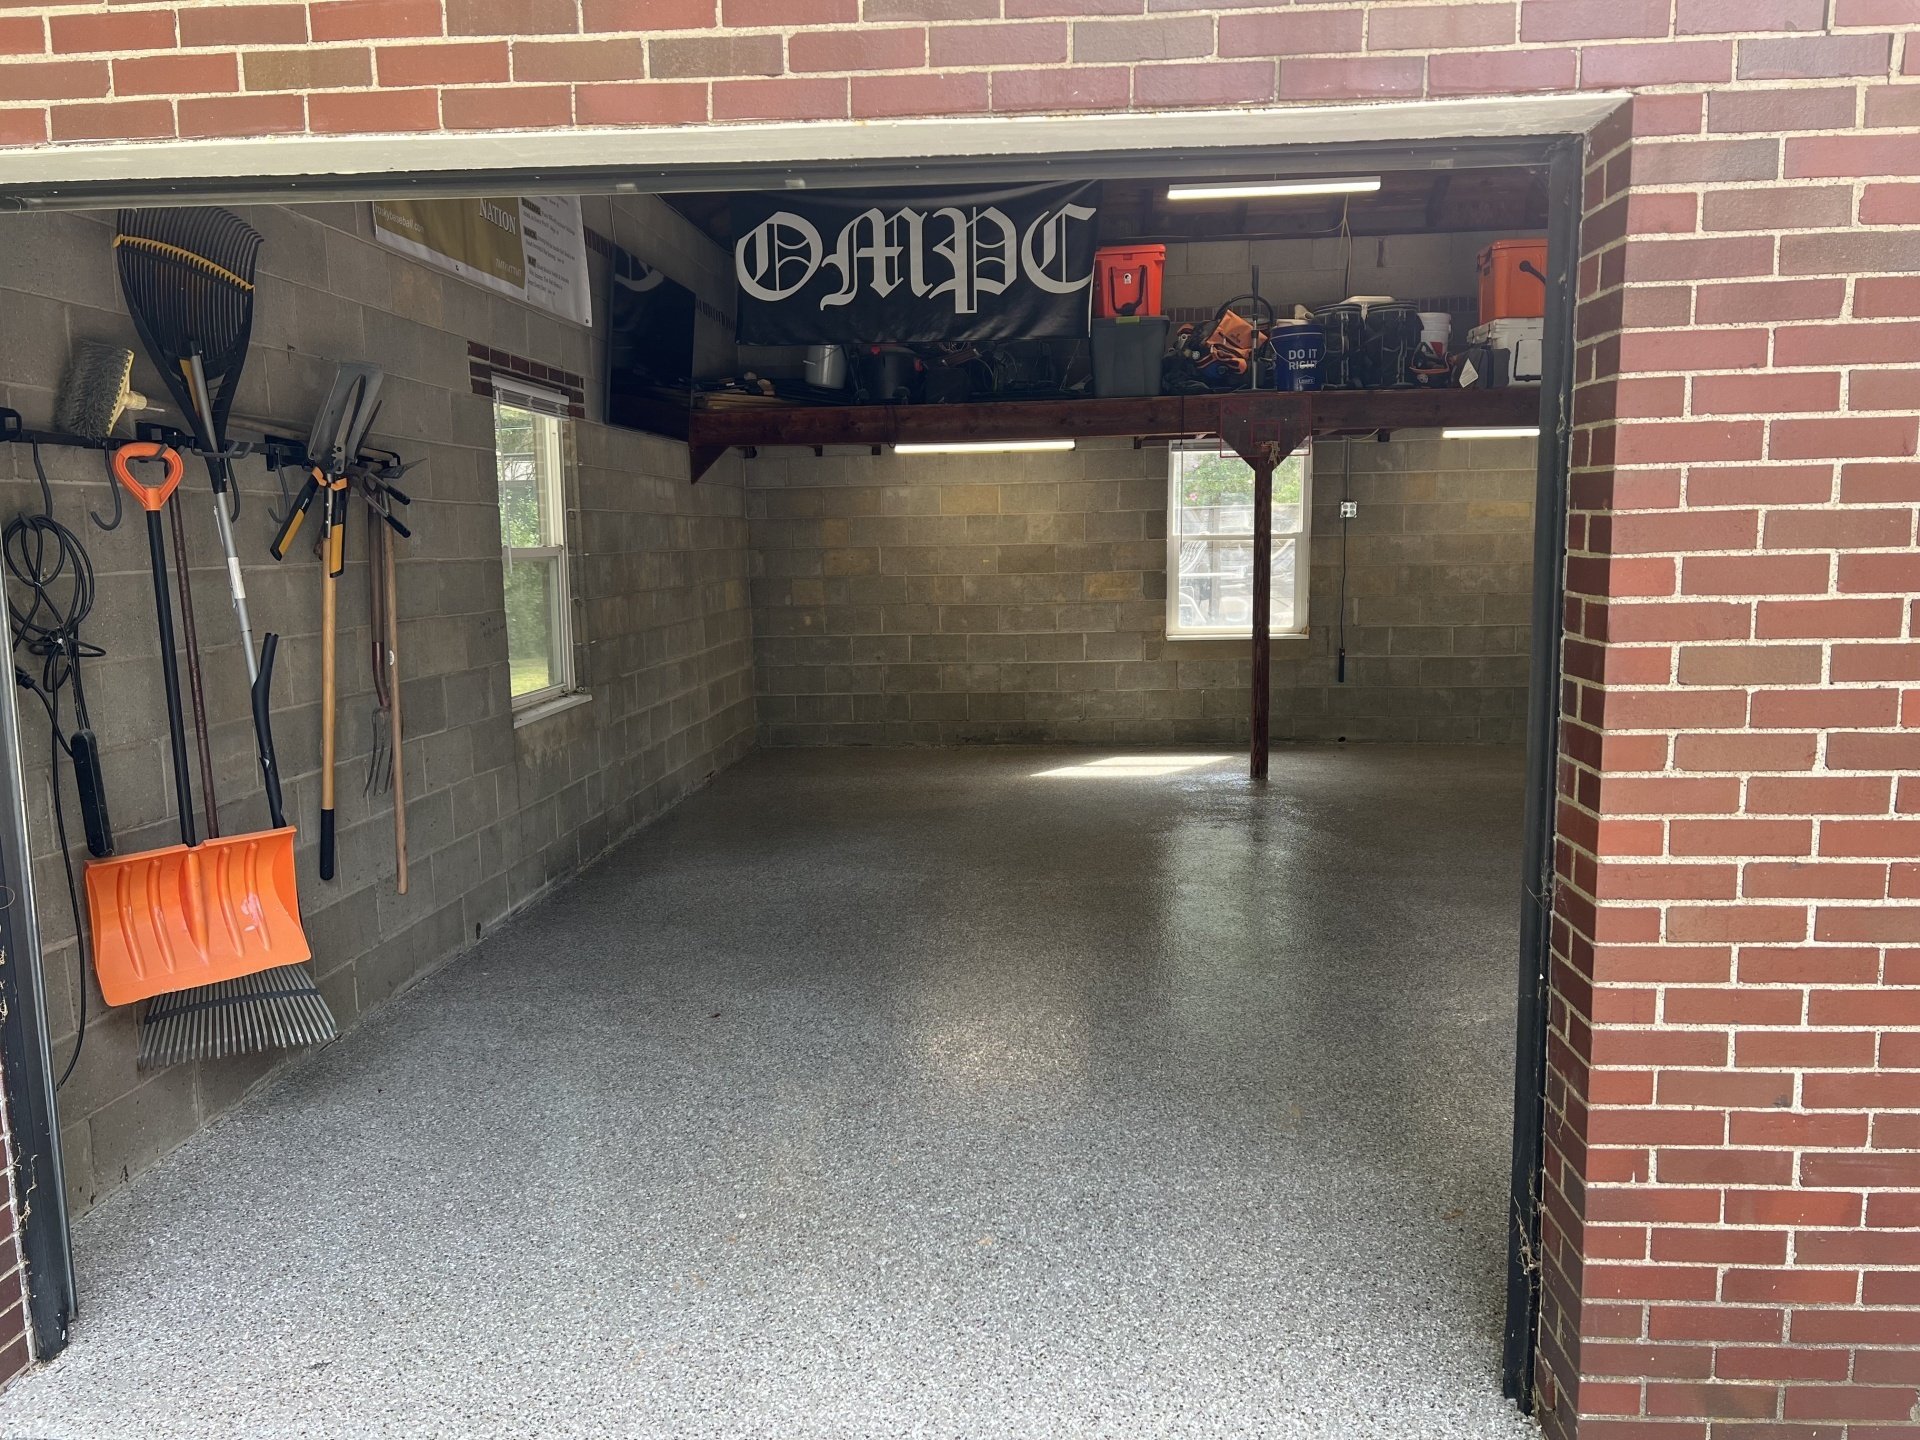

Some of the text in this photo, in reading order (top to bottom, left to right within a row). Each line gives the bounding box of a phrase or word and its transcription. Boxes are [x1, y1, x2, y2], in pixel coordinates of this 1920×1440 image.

[480, 198, 516, 235] NATION
[735, 203, 1097, 314] OMPC
[1288, 348, 1318, 360] DO IT
